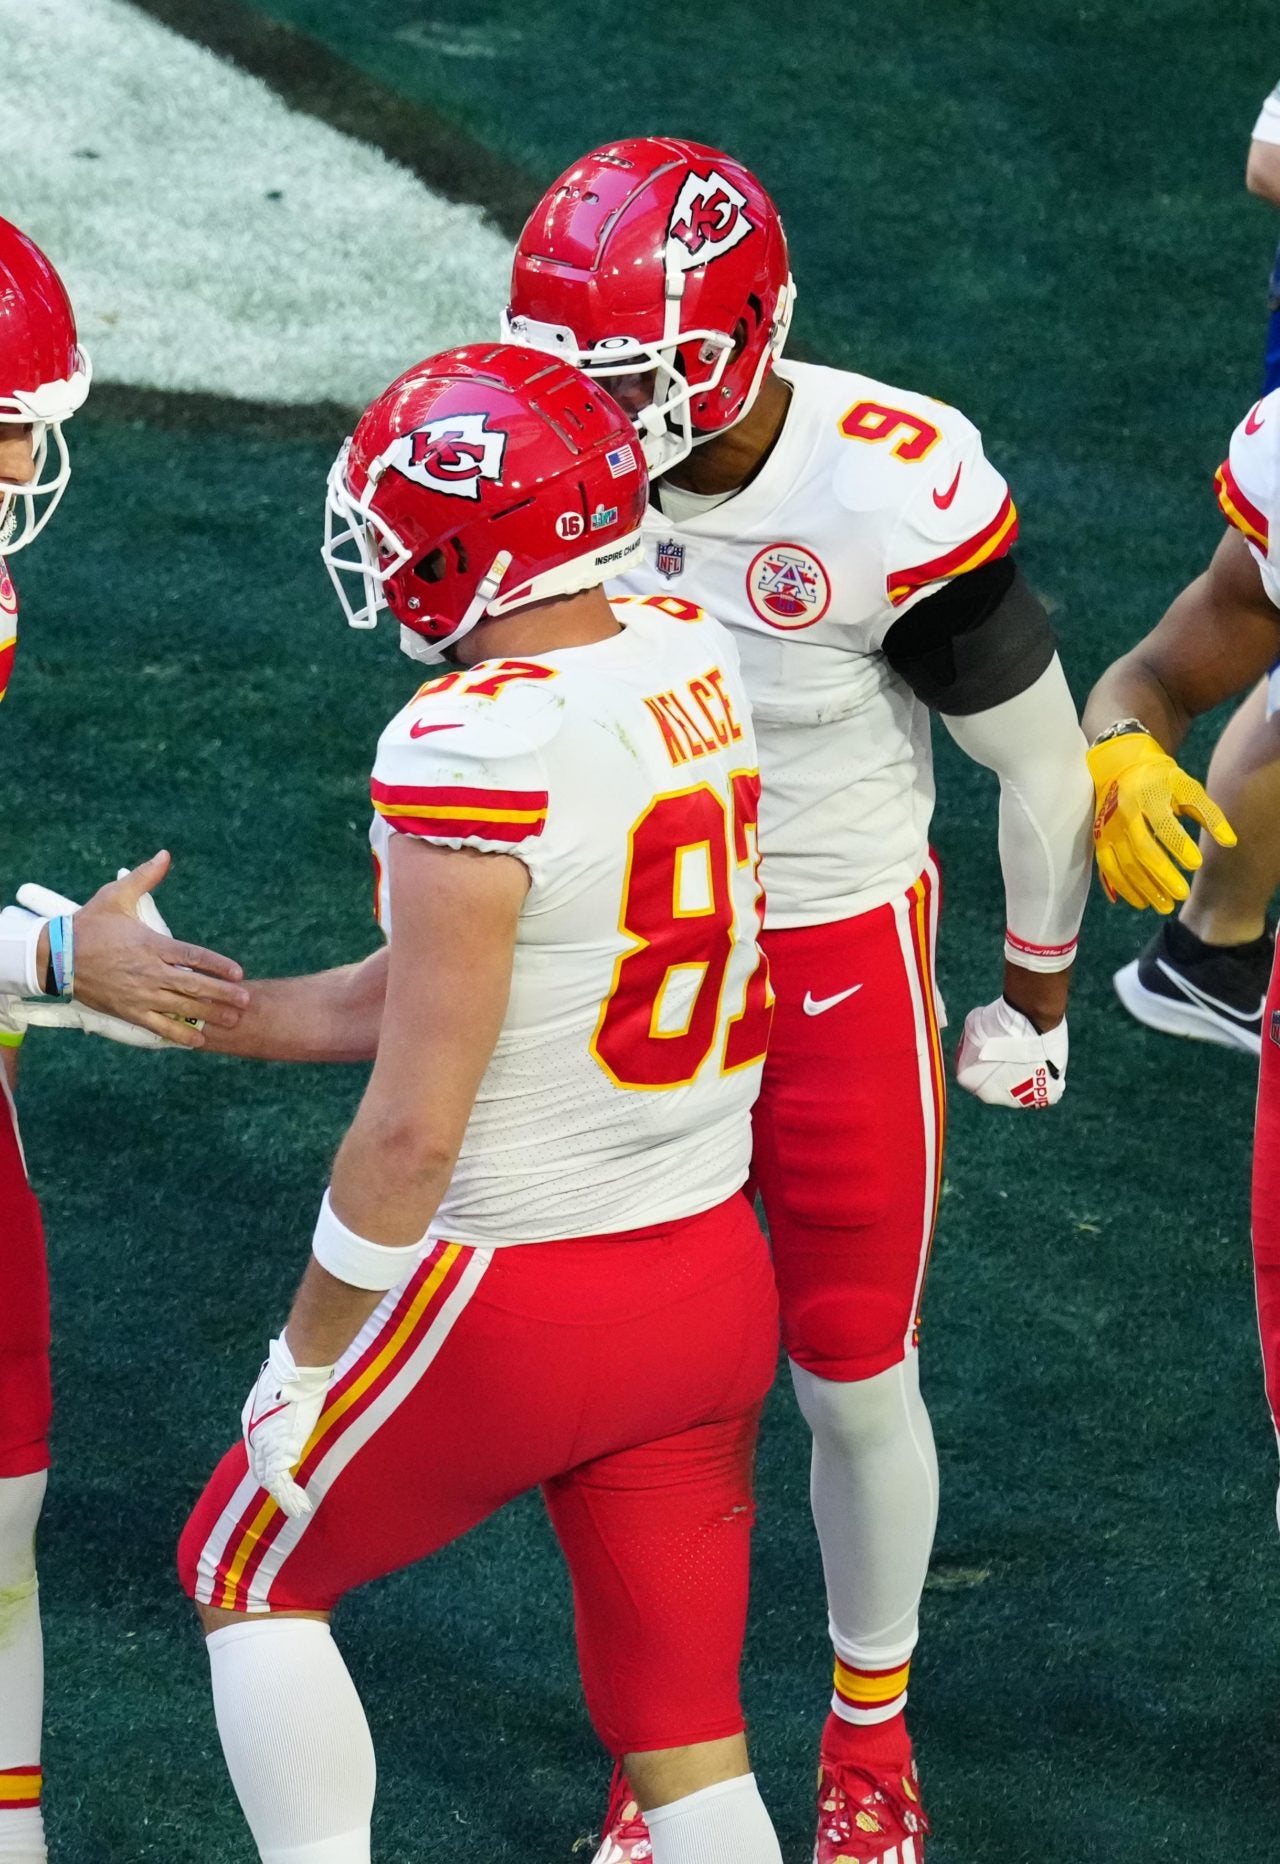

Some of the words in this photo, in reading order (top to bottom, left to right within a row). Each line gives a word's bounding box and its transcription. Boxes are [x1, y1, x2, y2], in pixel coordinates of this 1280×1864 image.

[670, 186, 741, 254] KC
[408, 429, 486, 482] KC
[837, 399, 942, 464] 9
[561, 515, 580, 537] 16
[594, 548, 623, 567] INSPIRE
[660, 556, 680, 572] NFL
[641, 665, 743, 768] KELCE
[588, 768, 775, 1091] 87
[1034, 1066, 1050, 1109] didas
